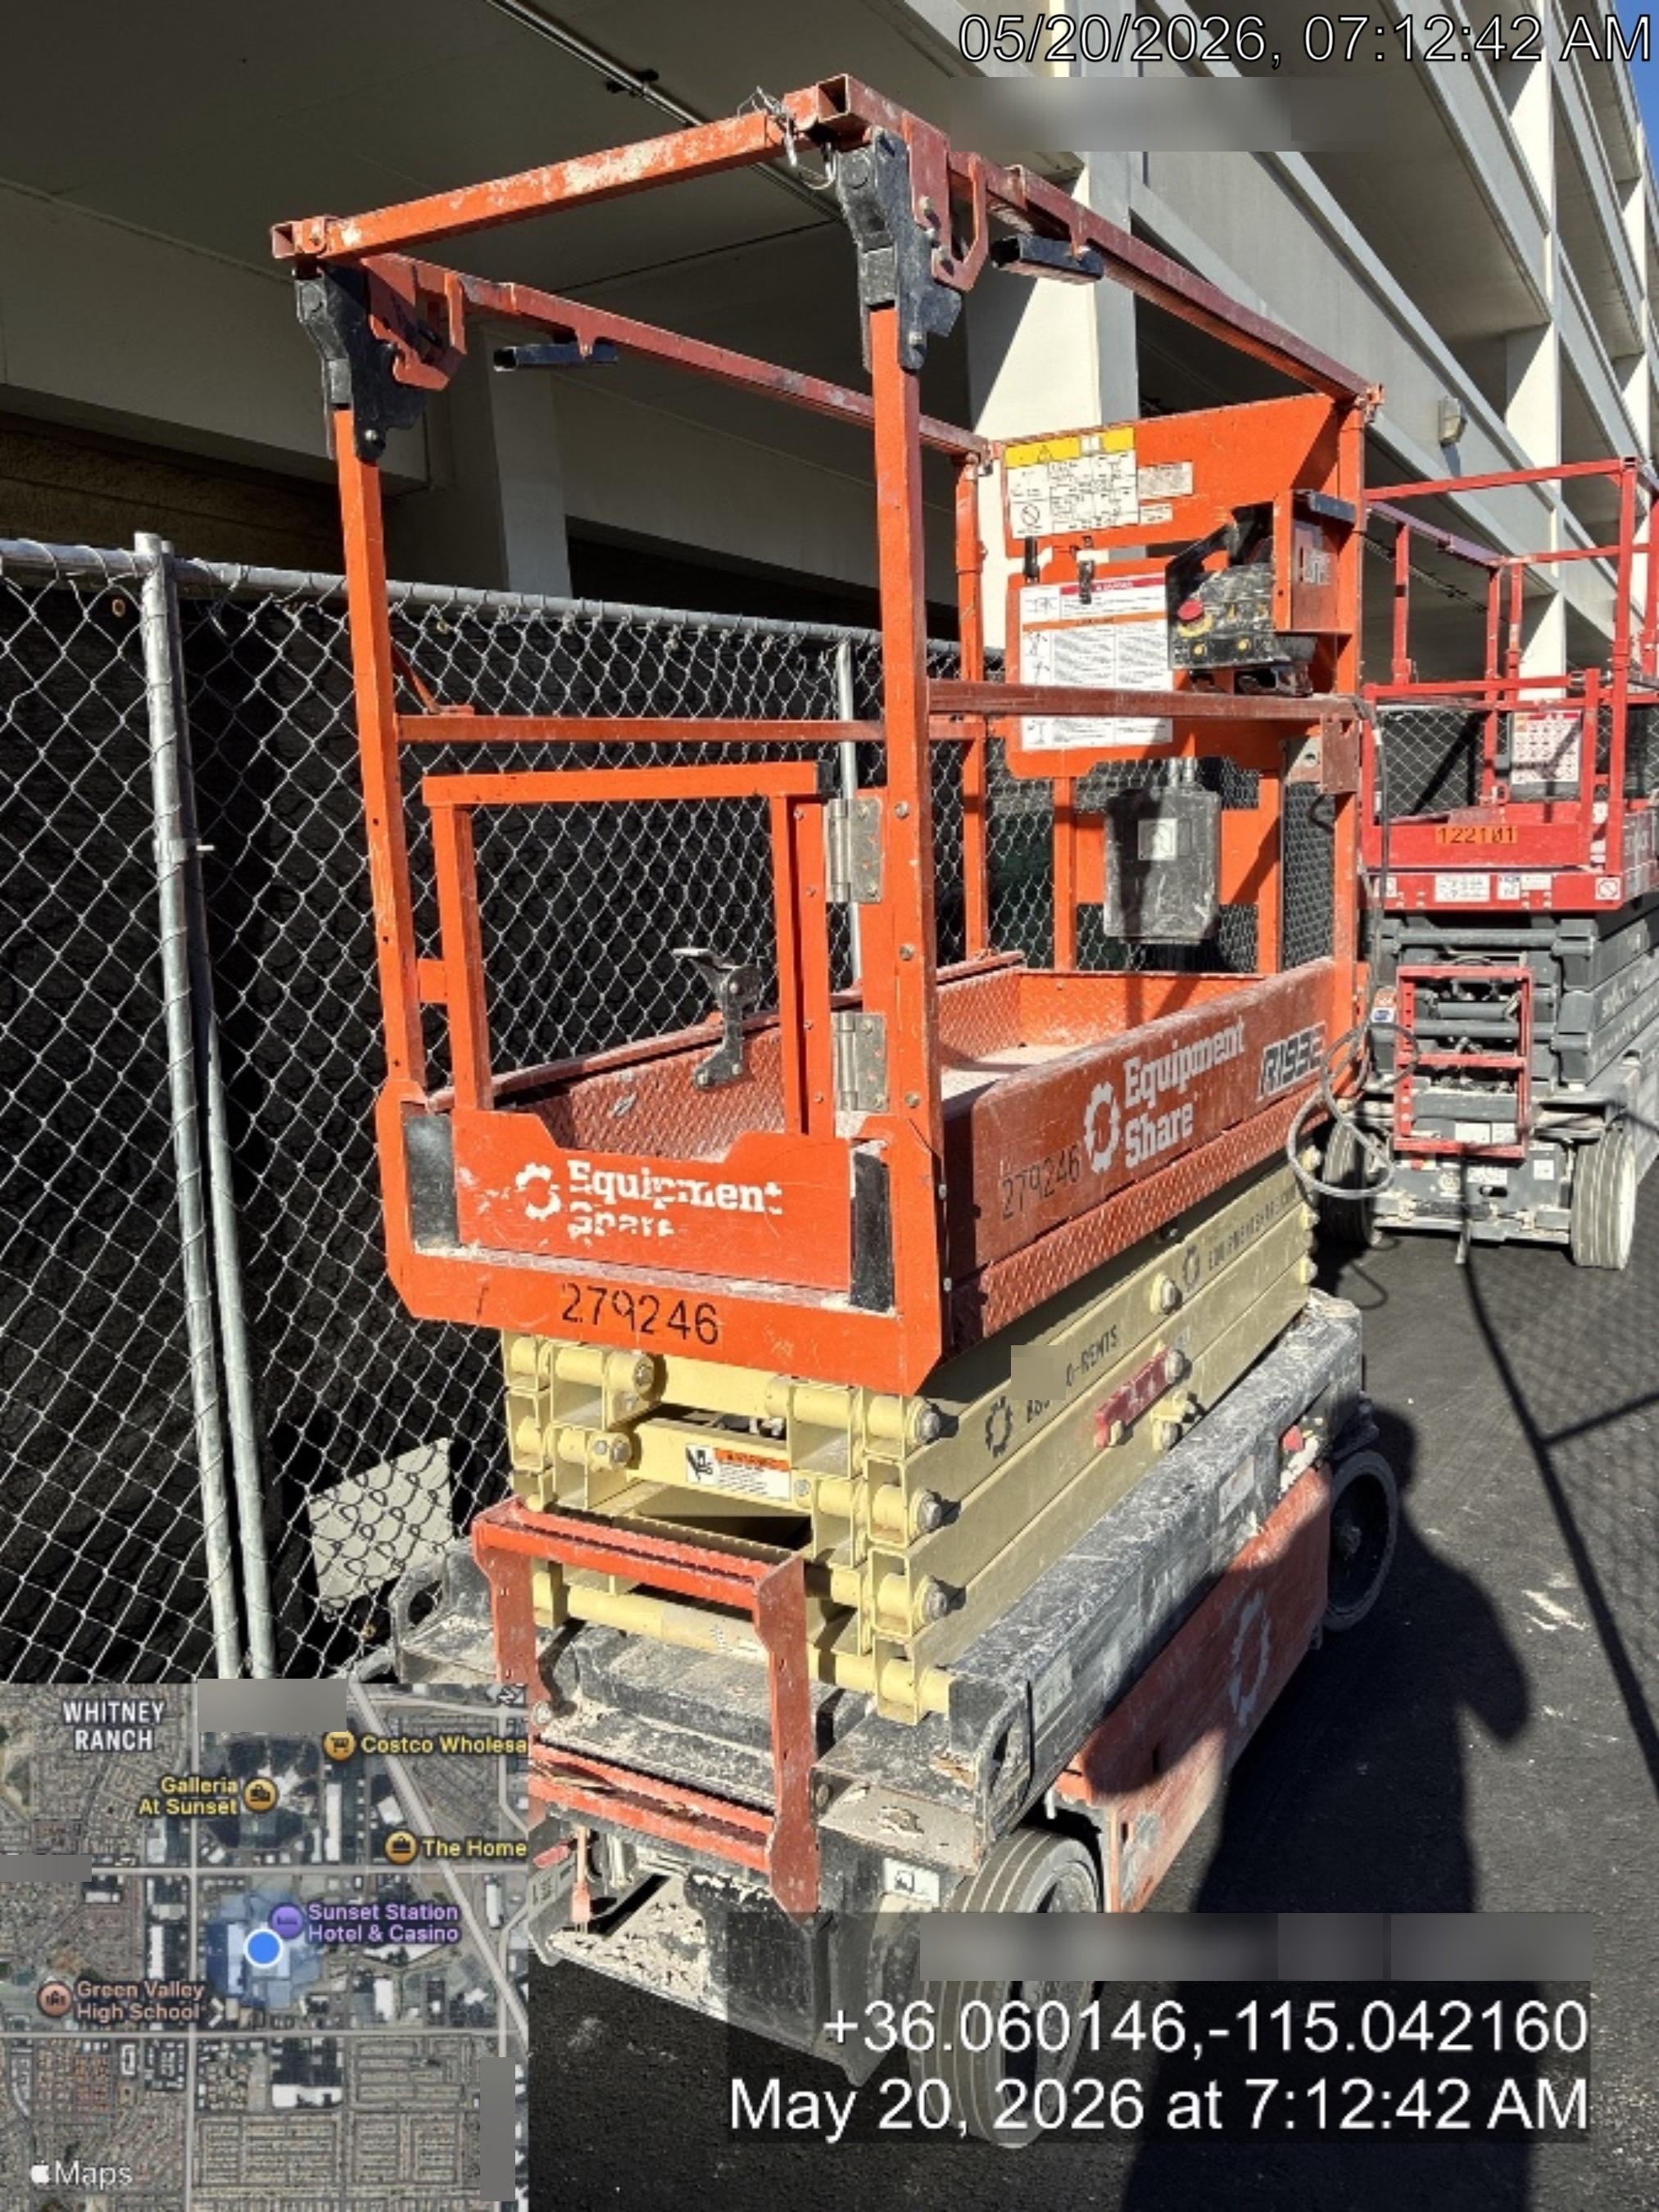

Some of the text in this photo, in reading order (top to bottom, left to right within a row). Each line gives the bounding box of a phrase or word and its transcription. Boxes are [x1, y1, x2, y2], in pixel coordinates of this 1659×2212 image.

[1123, 1018, 1245, 1109] Equipment
[1125, 1100, 1194, 1169] Share
[1000, 1144, 1081, 1220] 279246
[562, 1283, 719, 1345] 279246
